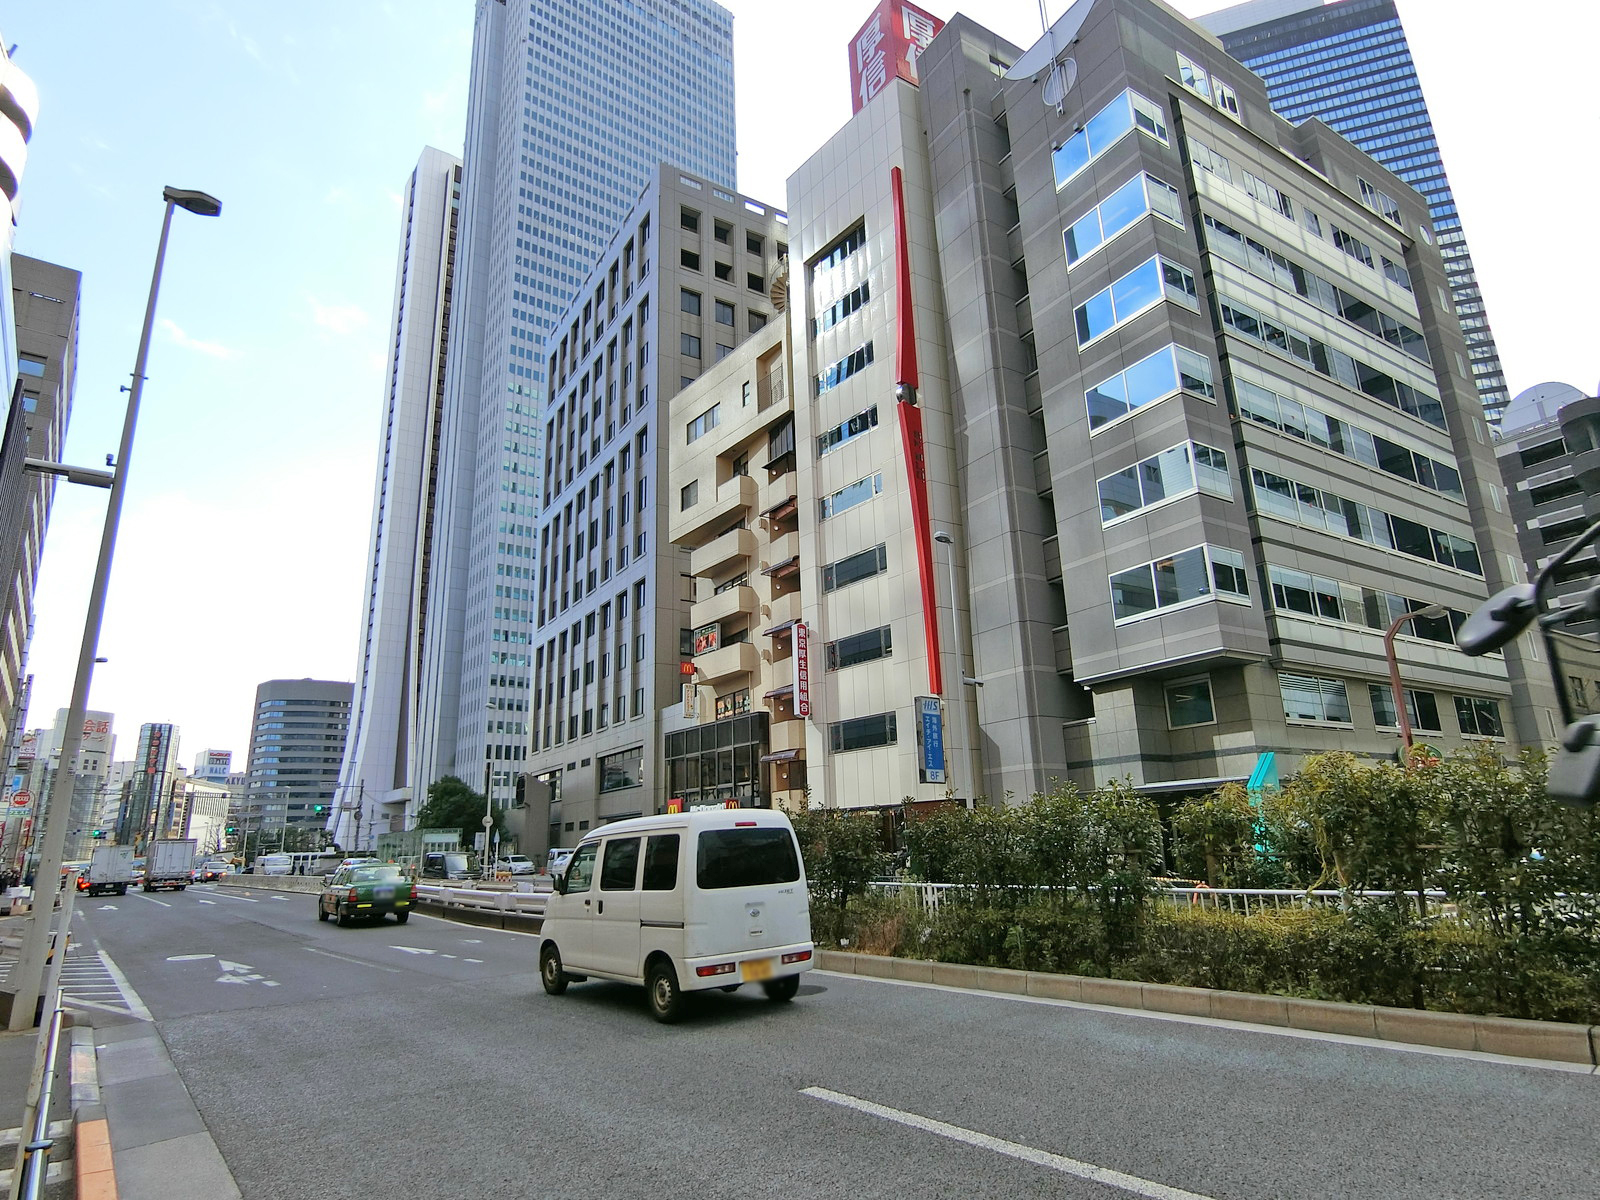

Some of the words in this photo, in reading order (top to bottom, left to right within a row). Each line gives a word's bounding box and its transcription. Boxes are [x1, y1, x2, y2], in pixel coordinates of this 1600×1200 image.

[855, 12, 886, 108] 厚信
[798, 627, 809, 713] 東京厚生信用組合
[925, 715, 933, 768] エイチ・アイ・エス
[931, 716, 939, 748] 海外旅行
[209, 766, 227, 774] HALC
[930, 771, 940, 780] 8F
